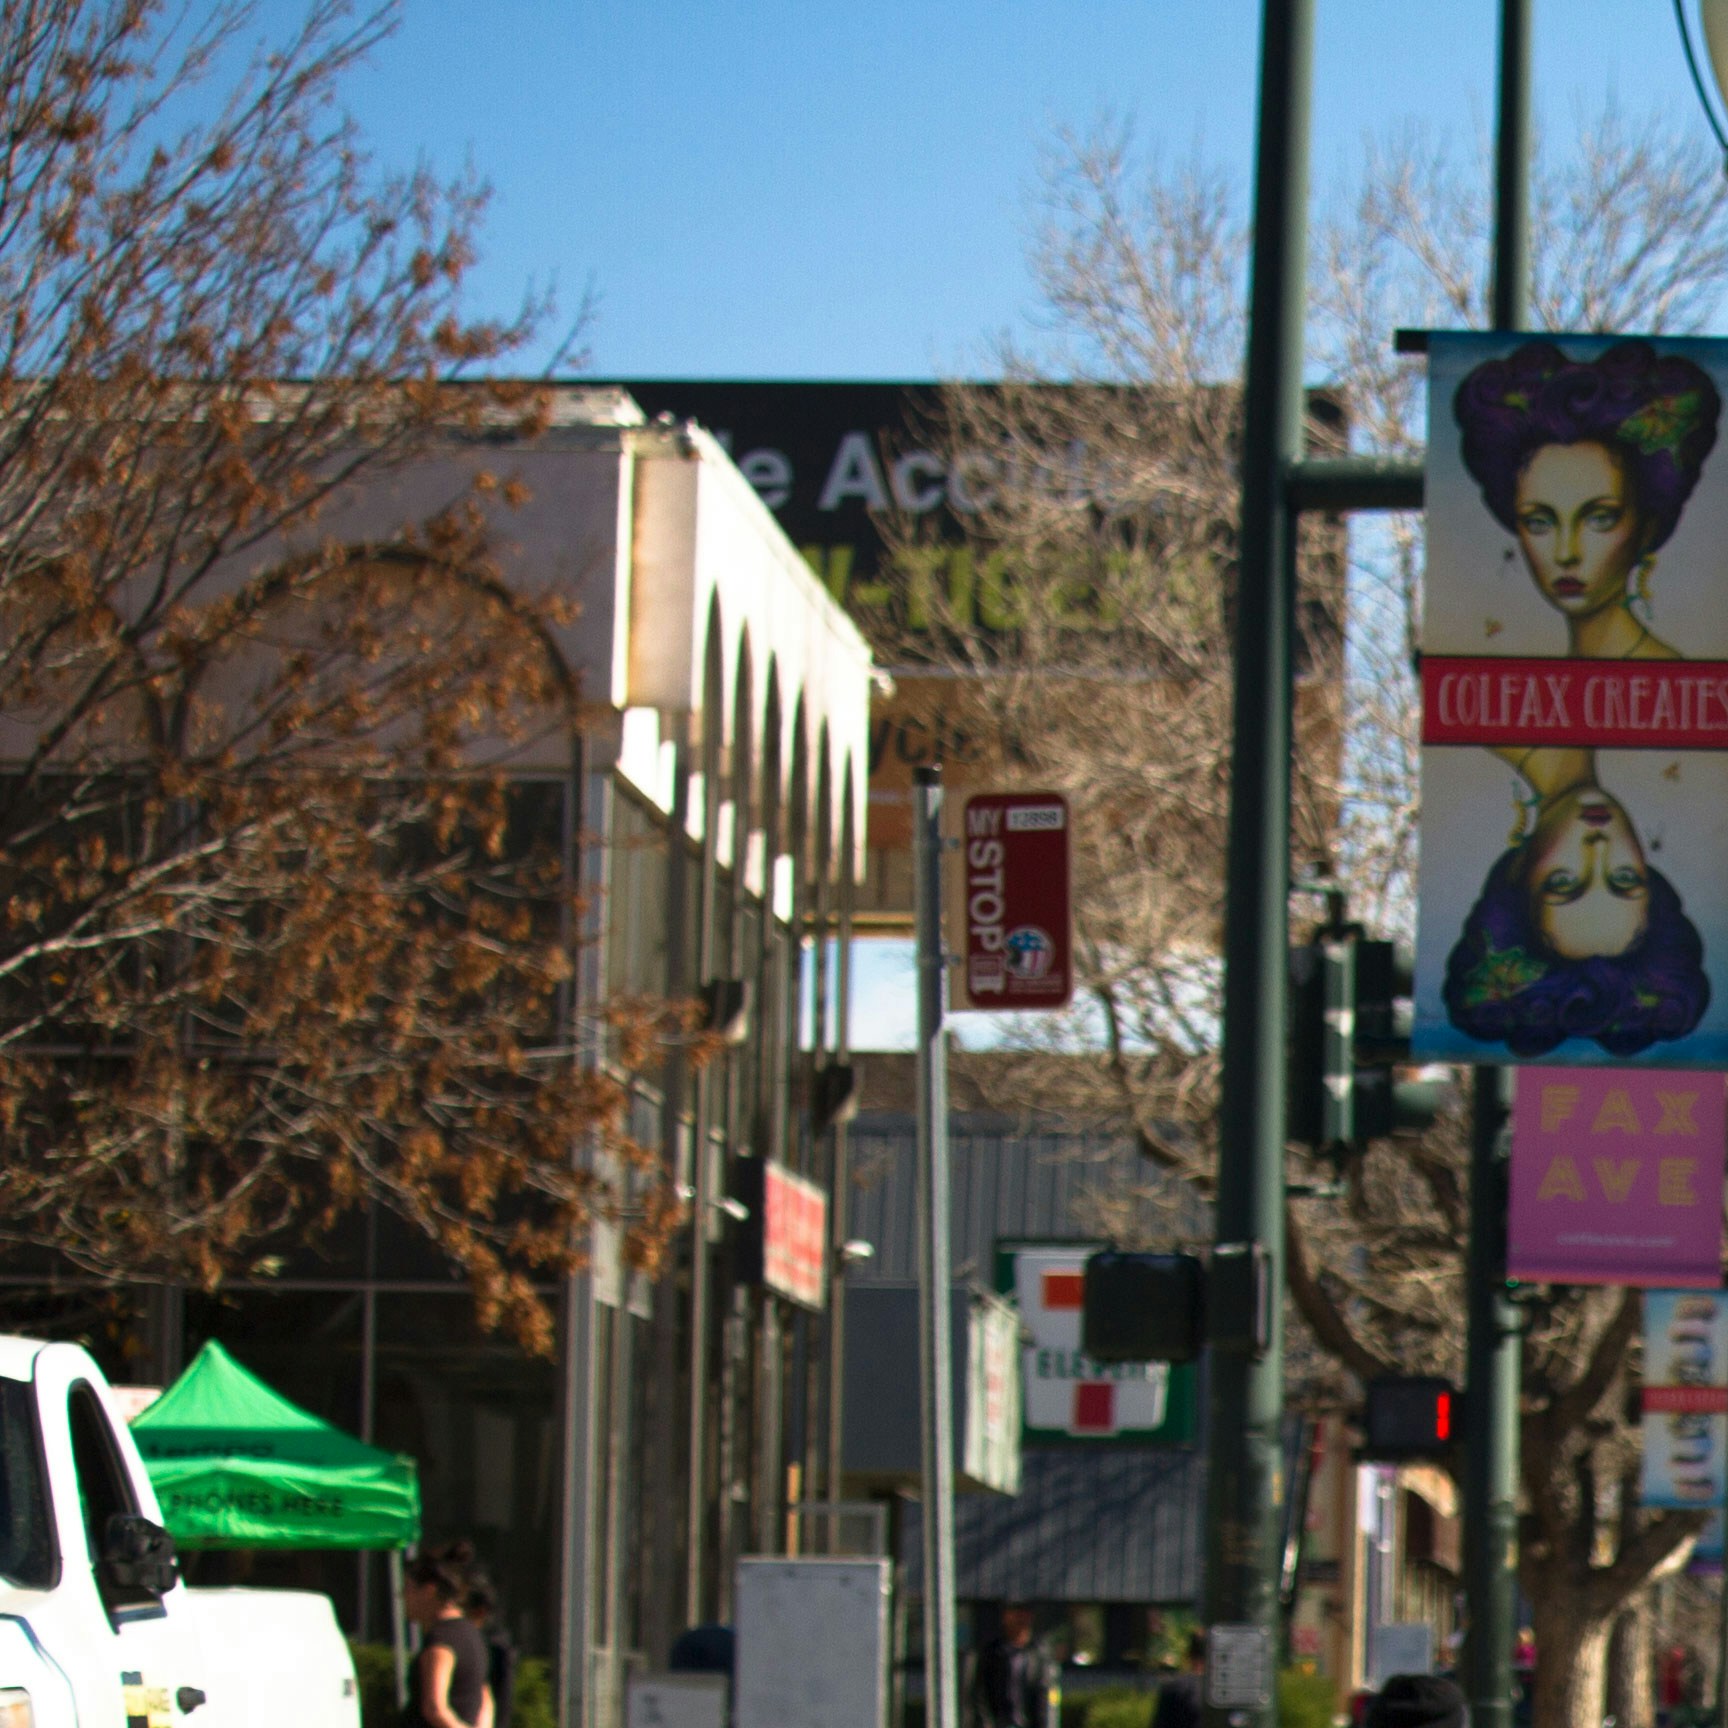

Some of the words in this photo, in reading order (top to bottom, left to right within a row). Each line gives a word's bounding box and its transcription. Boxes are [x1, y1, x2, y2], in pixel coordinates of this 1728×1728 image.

[1437, 672, 1574, 728] COLFAX
[968, 841, 1005, 952] STOP
[1540, 1084, 1700, 1136] FAX
[1536, 1154, 1699, 1206] AVE
